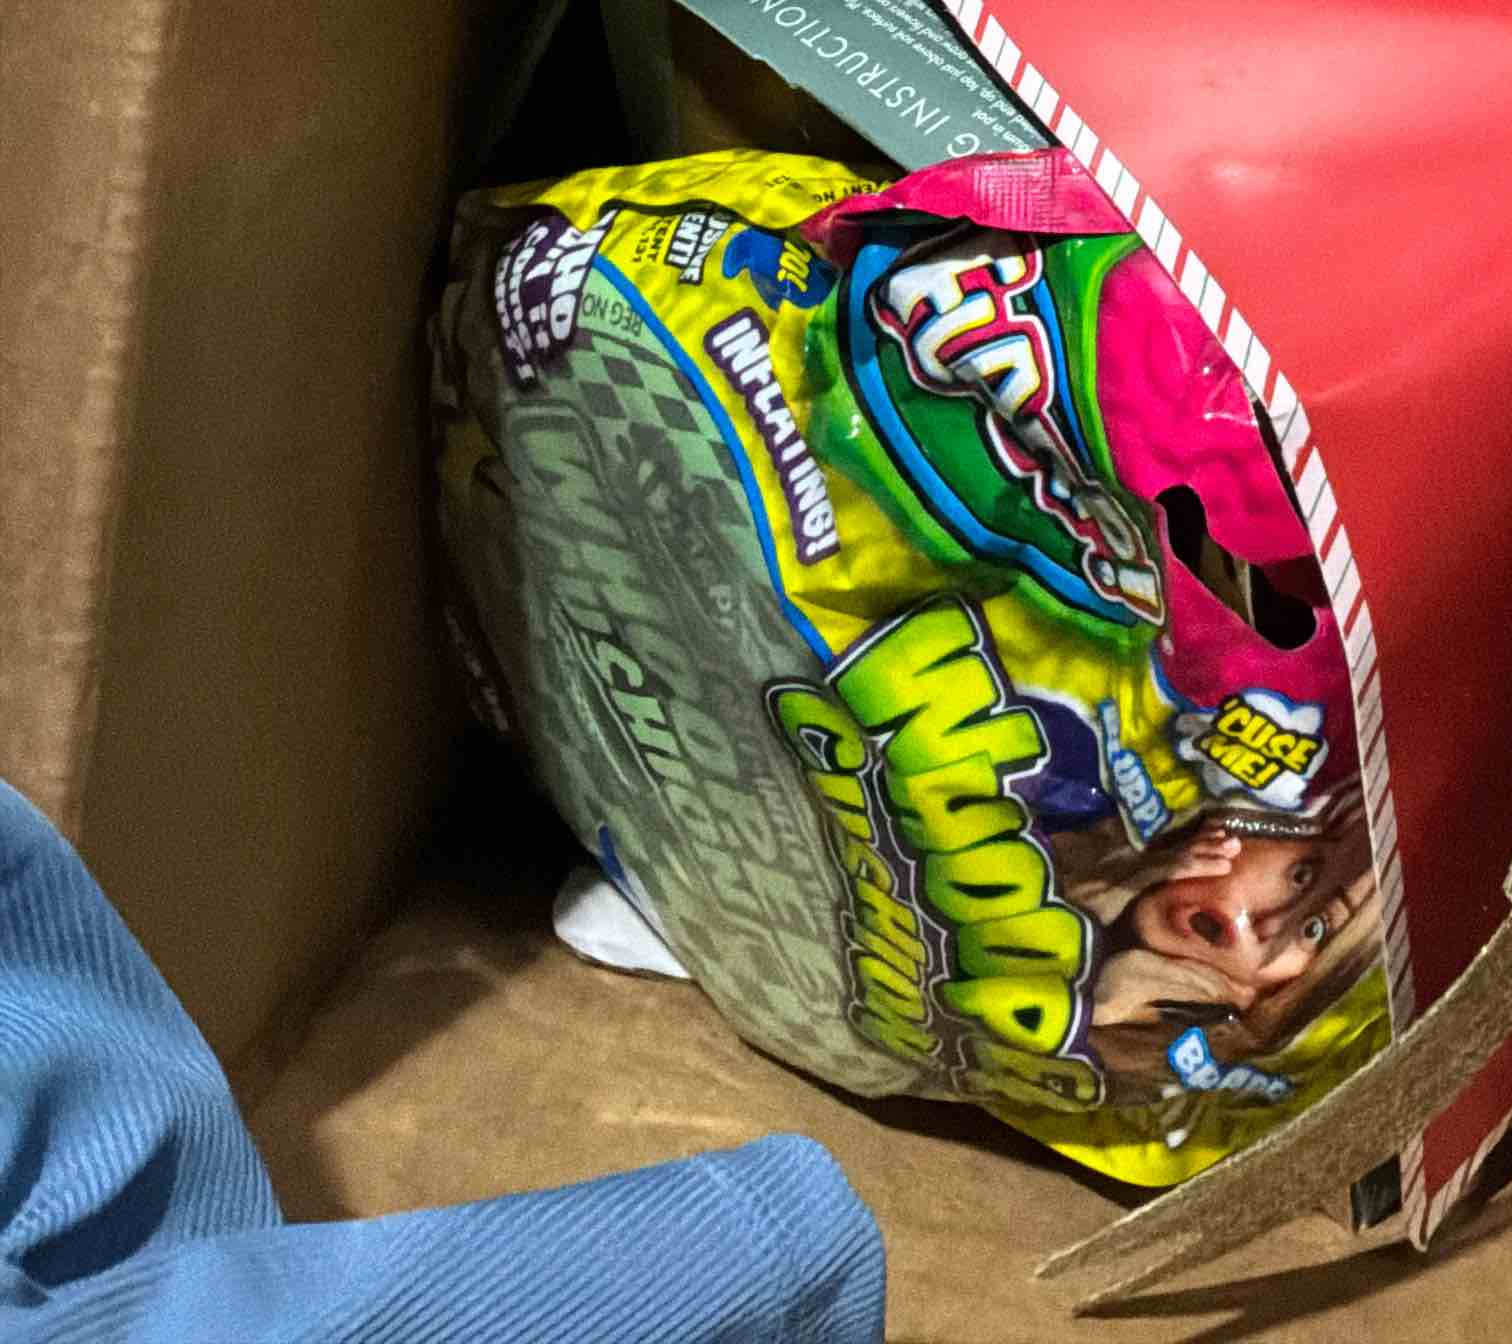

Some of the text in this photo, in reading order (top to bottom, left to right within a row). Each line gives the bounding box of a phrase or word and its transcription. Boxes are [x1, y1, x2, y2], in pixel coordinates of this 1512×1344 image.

[946, 134, 984, 158] G
[609, 297, 643, 337] REG
[712, 317, 839, 557] INFLATING!
[1200, 737, 1280, 788] ME!
[1218, 699, 1317, 772] 'CUSE
[775, 690, 936, 1058] CUSHION
